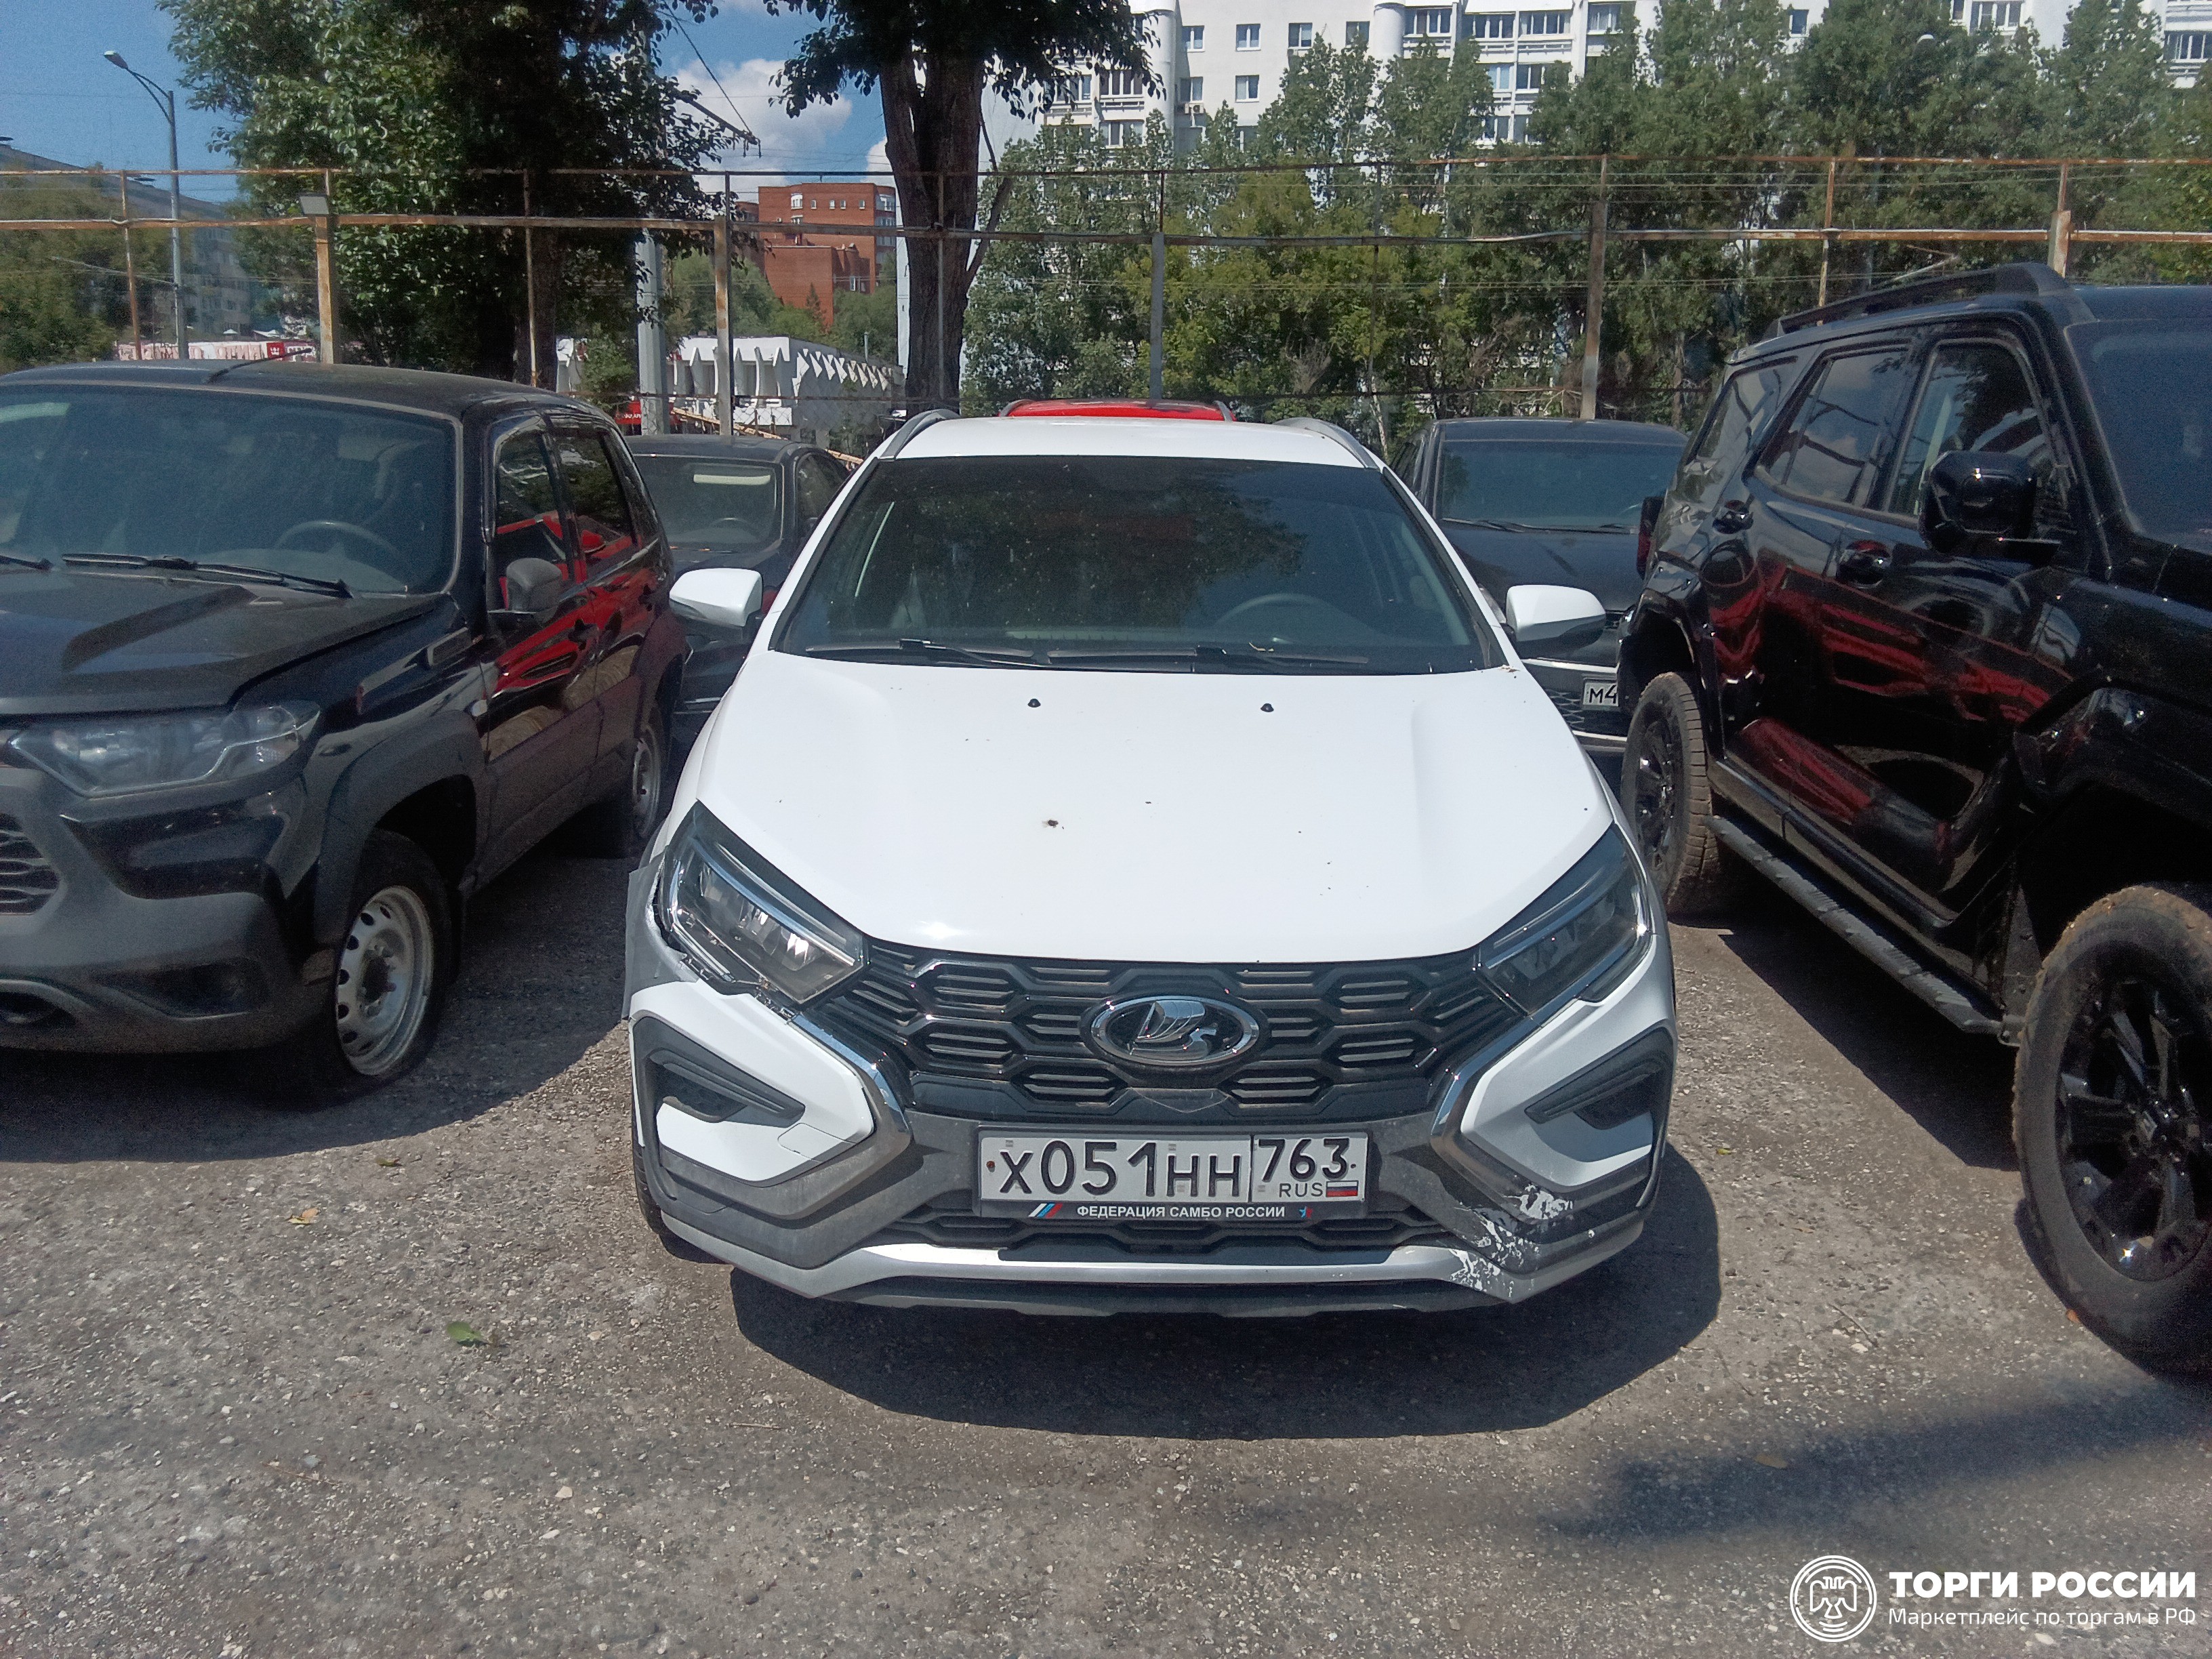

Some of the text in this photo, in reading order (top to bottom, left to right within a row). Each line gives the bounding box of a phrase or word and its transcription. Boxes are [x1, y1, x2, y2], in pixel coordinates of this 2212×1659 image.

[998, 1138, 1351, 1197] Х051НН 763
[1278, 1182, 1324, 1197] RUS
[1077, 1205, 1286, 1219] ФЕДЕРАЦИЯ САМБО РОССИИ
